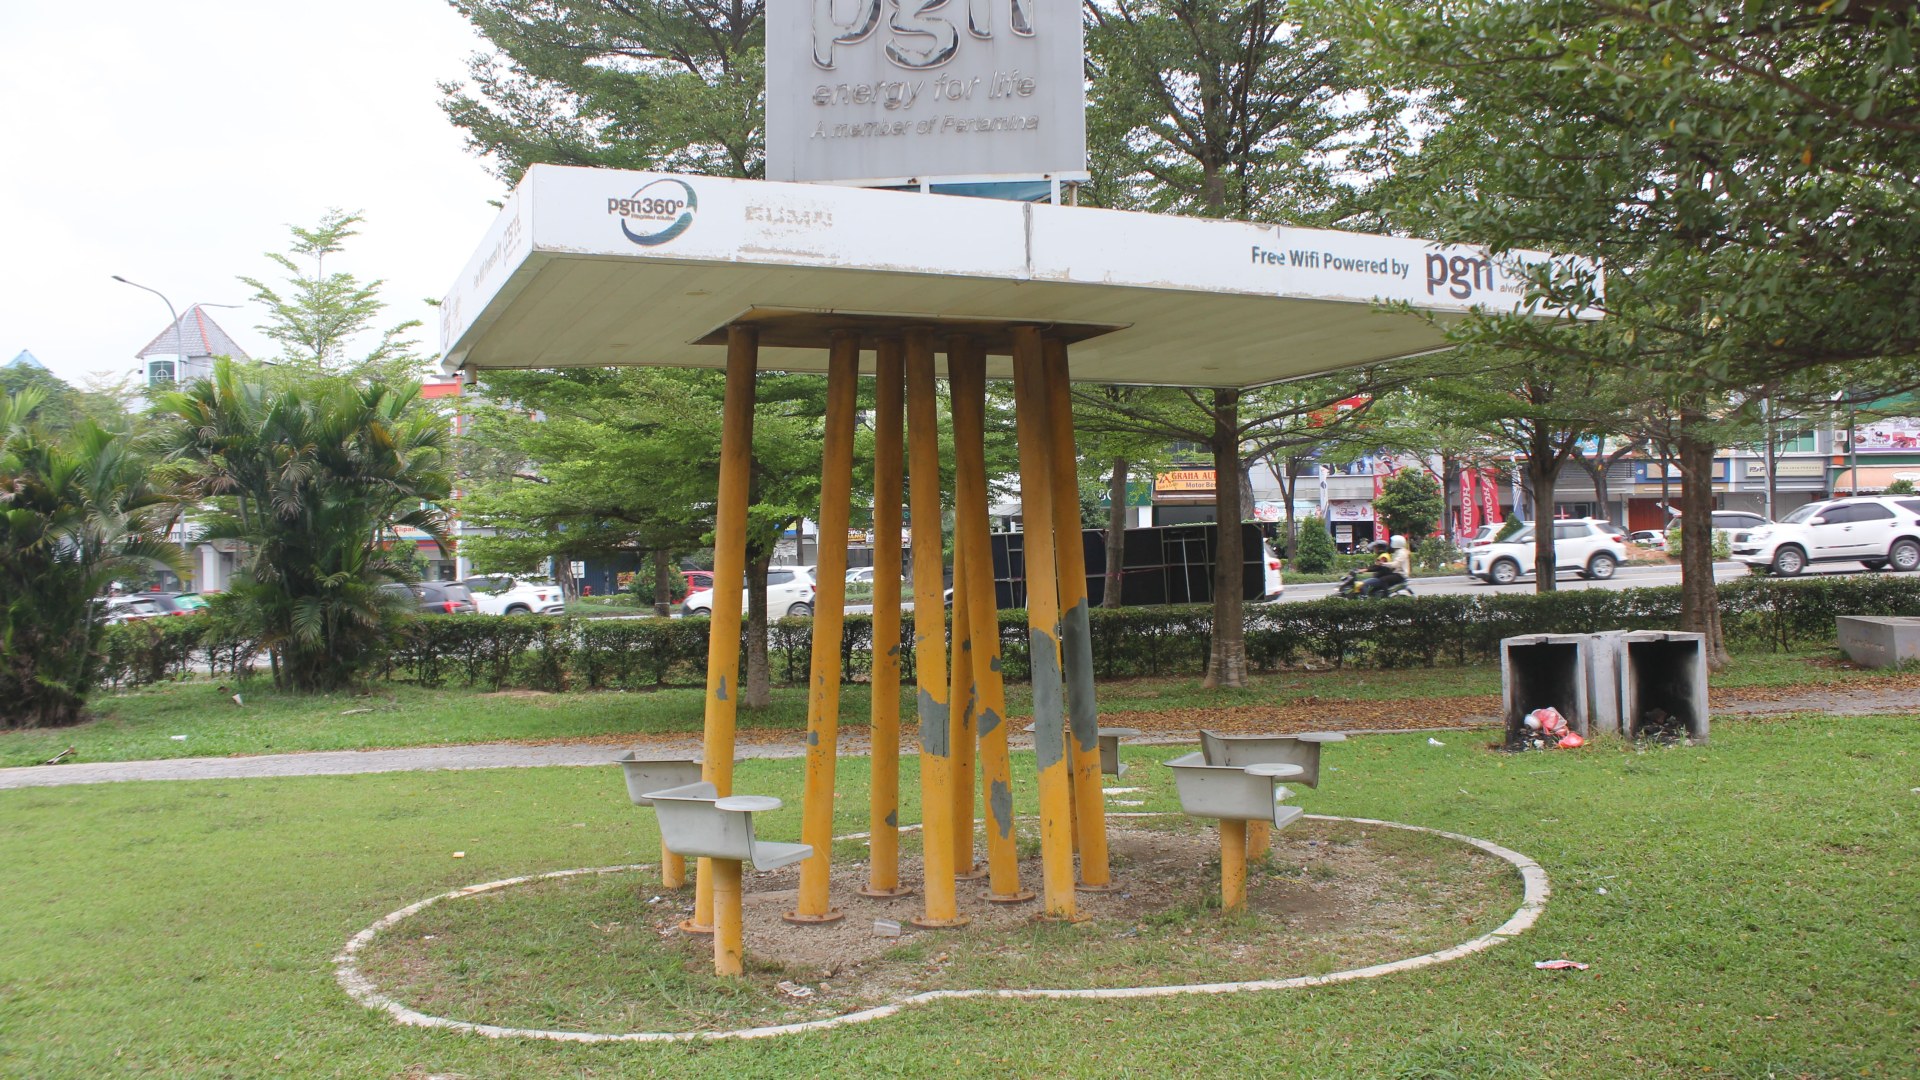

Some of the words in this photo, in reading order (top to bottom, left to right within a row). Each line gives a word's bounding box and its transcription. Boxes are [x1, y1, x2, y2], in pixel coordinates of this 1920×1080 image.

[812, 80, 926, 111] energy
[934, 73, 981, 102] for
[988, 69, 1037, 99] life
[810, 120, 827, 139] A
[831, 117, 914, 138] member
[917, 115, 938, 135] of
[941, 112, 1040, 134] Pertamina
[1251, 245, 1286, 266] Free
[1289, 249, 1320, 269] Wifi
[1323, 252, 1388, 275] Powered
[1391, 257, 1410, 281] by
[1425, 252, 1494, 300] pgn
[1171, 471, 1199, 480] GRAHA
[1462, 486, 1473, 536] HONDA
[1482, 486, 1494, 525] HOND
